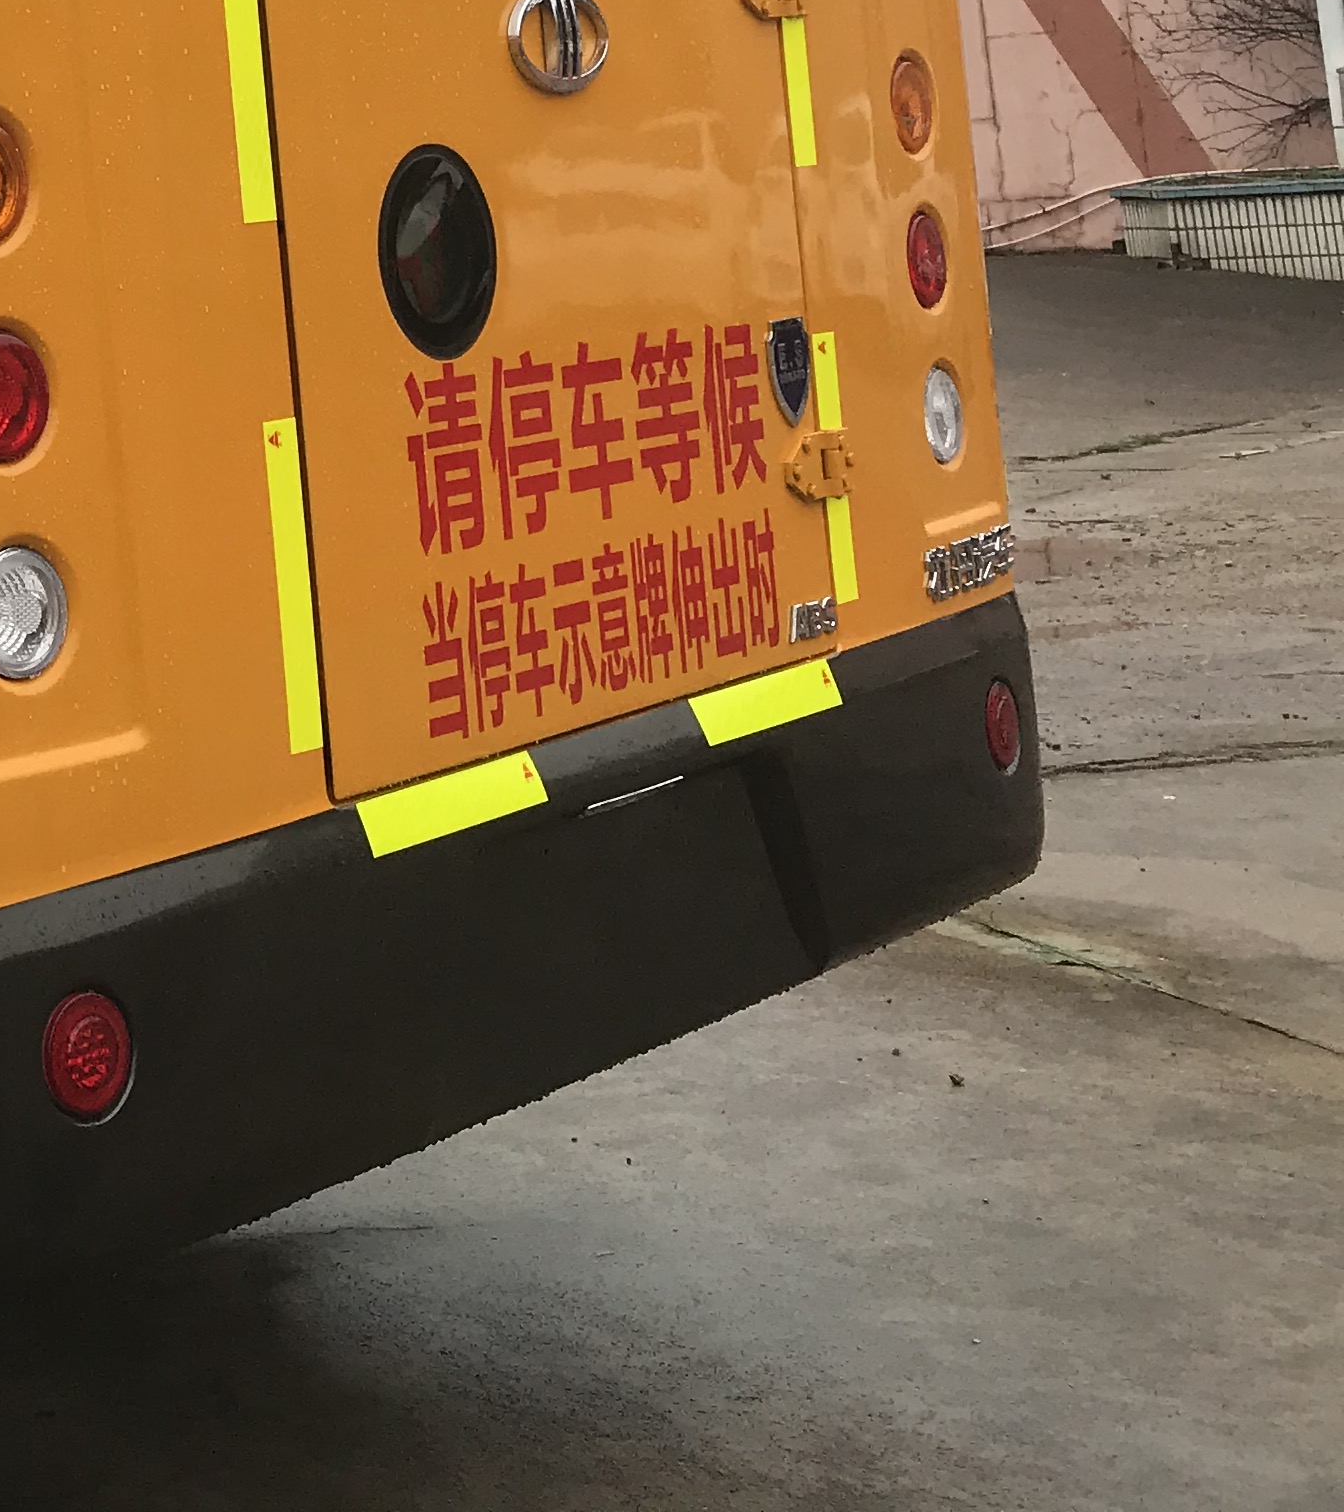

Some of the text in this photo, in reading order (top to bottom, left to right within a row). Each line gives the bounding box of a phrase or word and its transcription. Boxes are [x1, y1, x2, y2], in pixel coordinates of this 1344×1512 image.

[404, 323, 768, 556] 请停车等候
[422, 508, 780, 739] 当停车示意牌伸出时
[790, 596, 838, 643] ABS
